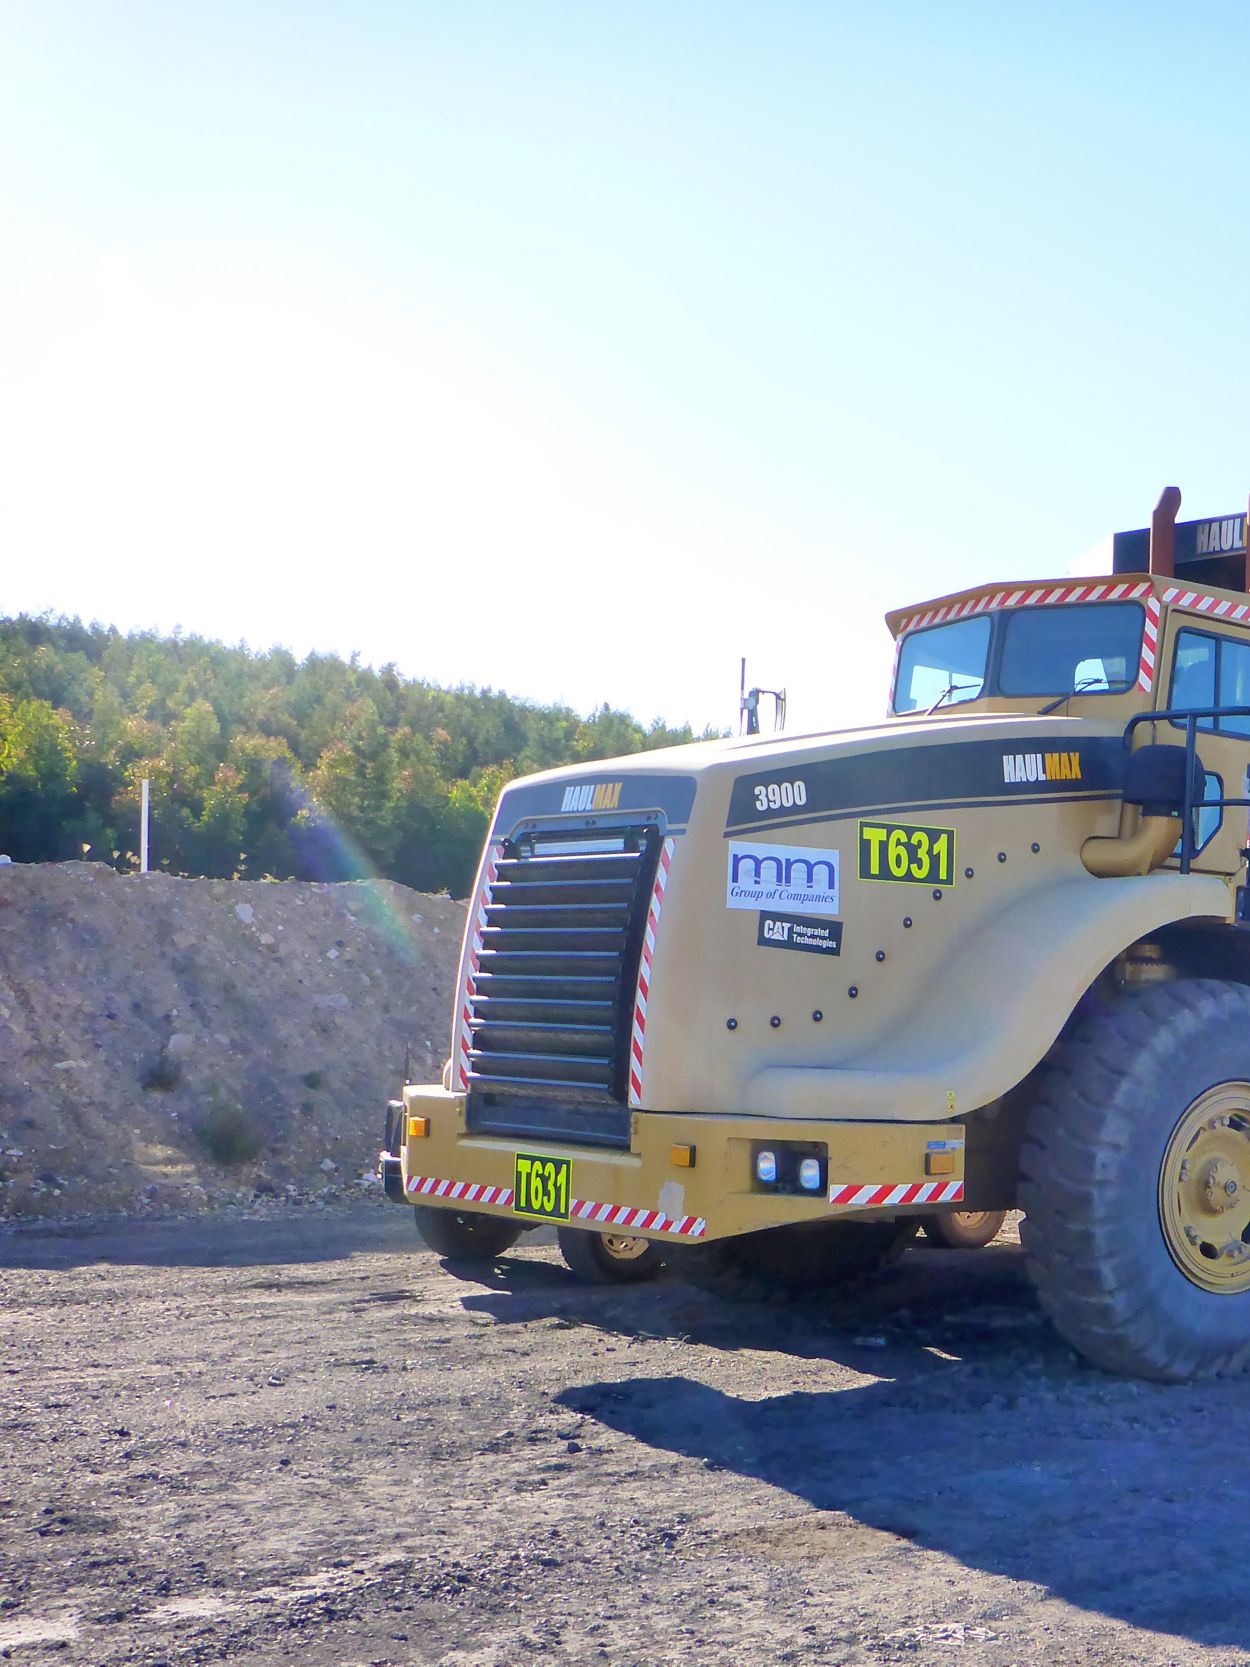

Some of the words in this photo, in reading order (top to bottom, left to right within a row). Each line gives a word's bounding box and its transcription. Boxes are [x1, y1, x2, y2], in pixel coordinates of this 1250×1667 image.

[1002, 752, 1082, 783] HAULMAX
[561, 782, 623, 812] HAULMAX
[754, 780, 807, 811] 3900
[862, 826, 949, 880] T631
[731, 853, 835, 890] mm
[731, 886, 764, 901] Group
[765, 889, 778, 900] of
[779, 889, 836, 904] Companies
[763, 919, 792, 941] CAT
[793, 924, 830, 937] Integrated
[793, 934, 837, 949] Technologies
[517, 1159, 567, 1214] T631
